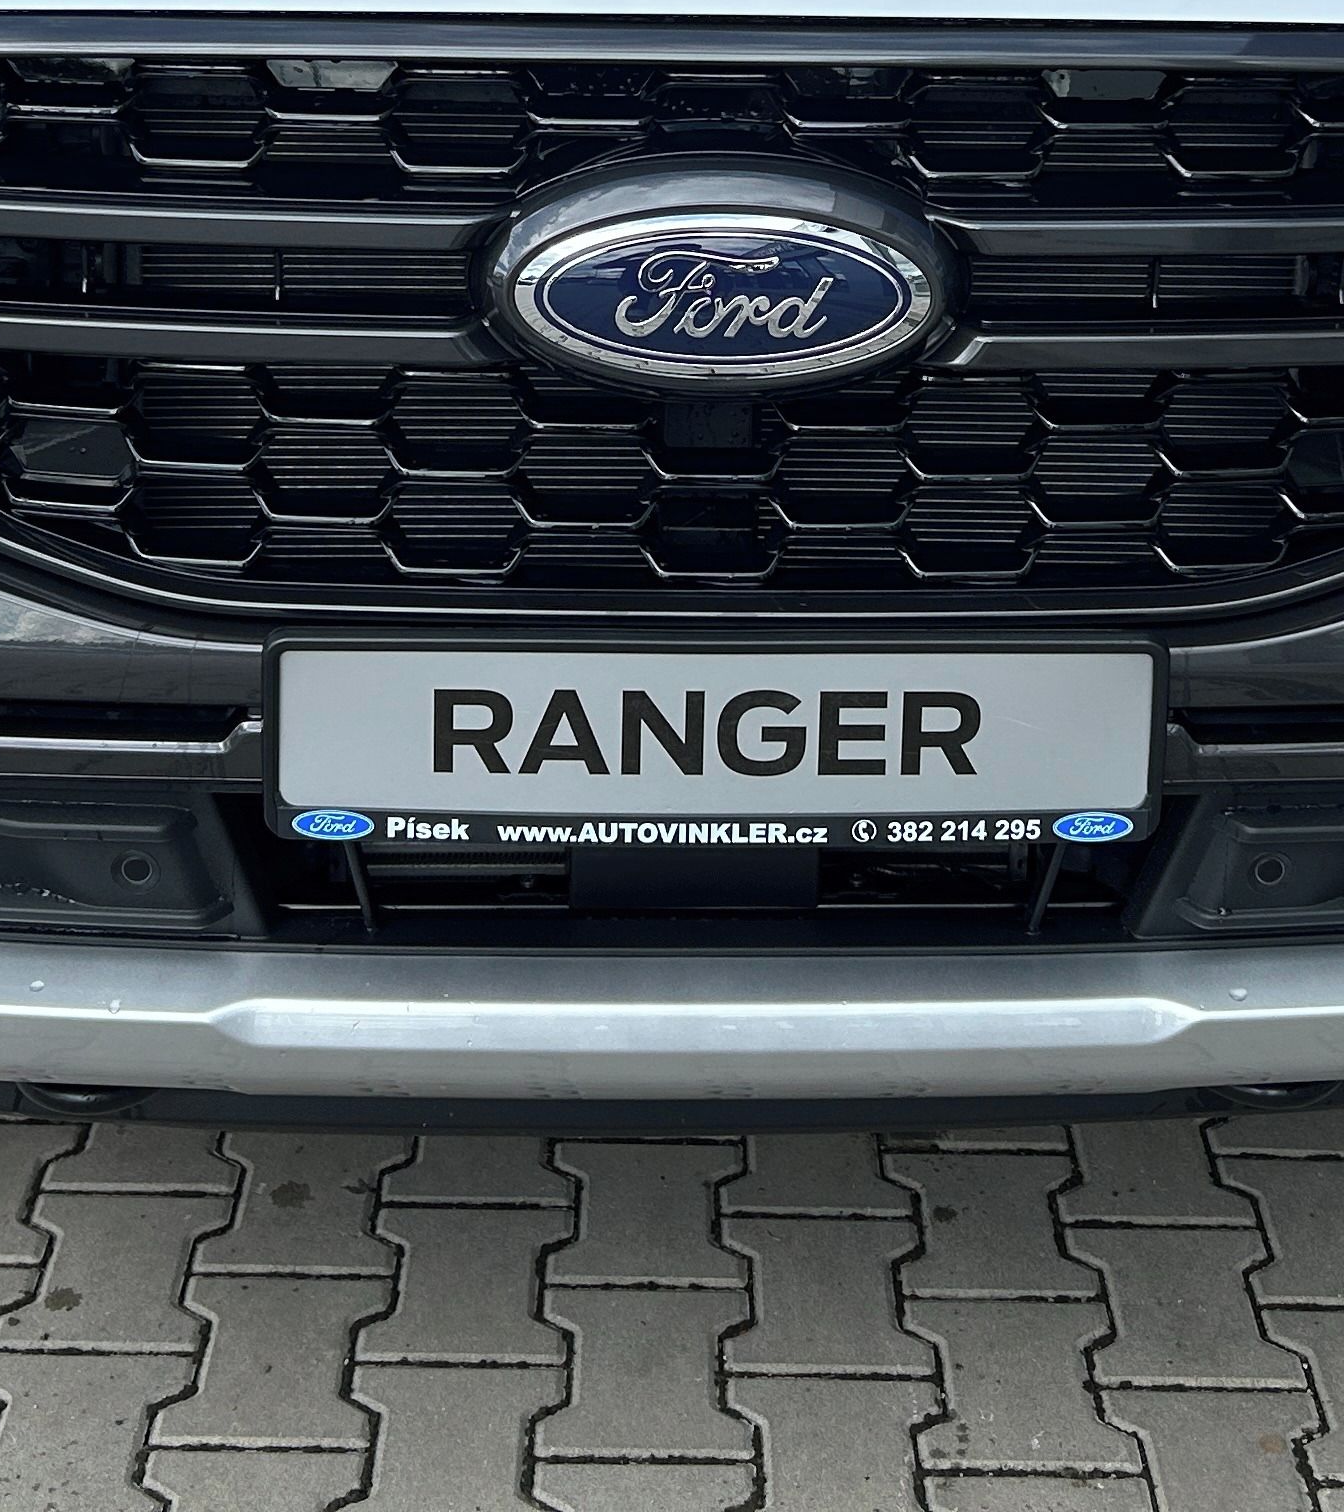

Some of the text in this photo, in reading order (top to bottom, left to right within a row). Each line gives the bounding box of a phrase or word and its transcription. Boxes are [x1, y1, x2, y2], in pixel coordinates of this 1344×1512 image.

[614, 250, 835, 340] Ford
[432, 687, 982, 777] RANGER
[308, 813, 1117, 844] Ford Písek www.AUTOVINKLER.cz 382 214 295 Ford
